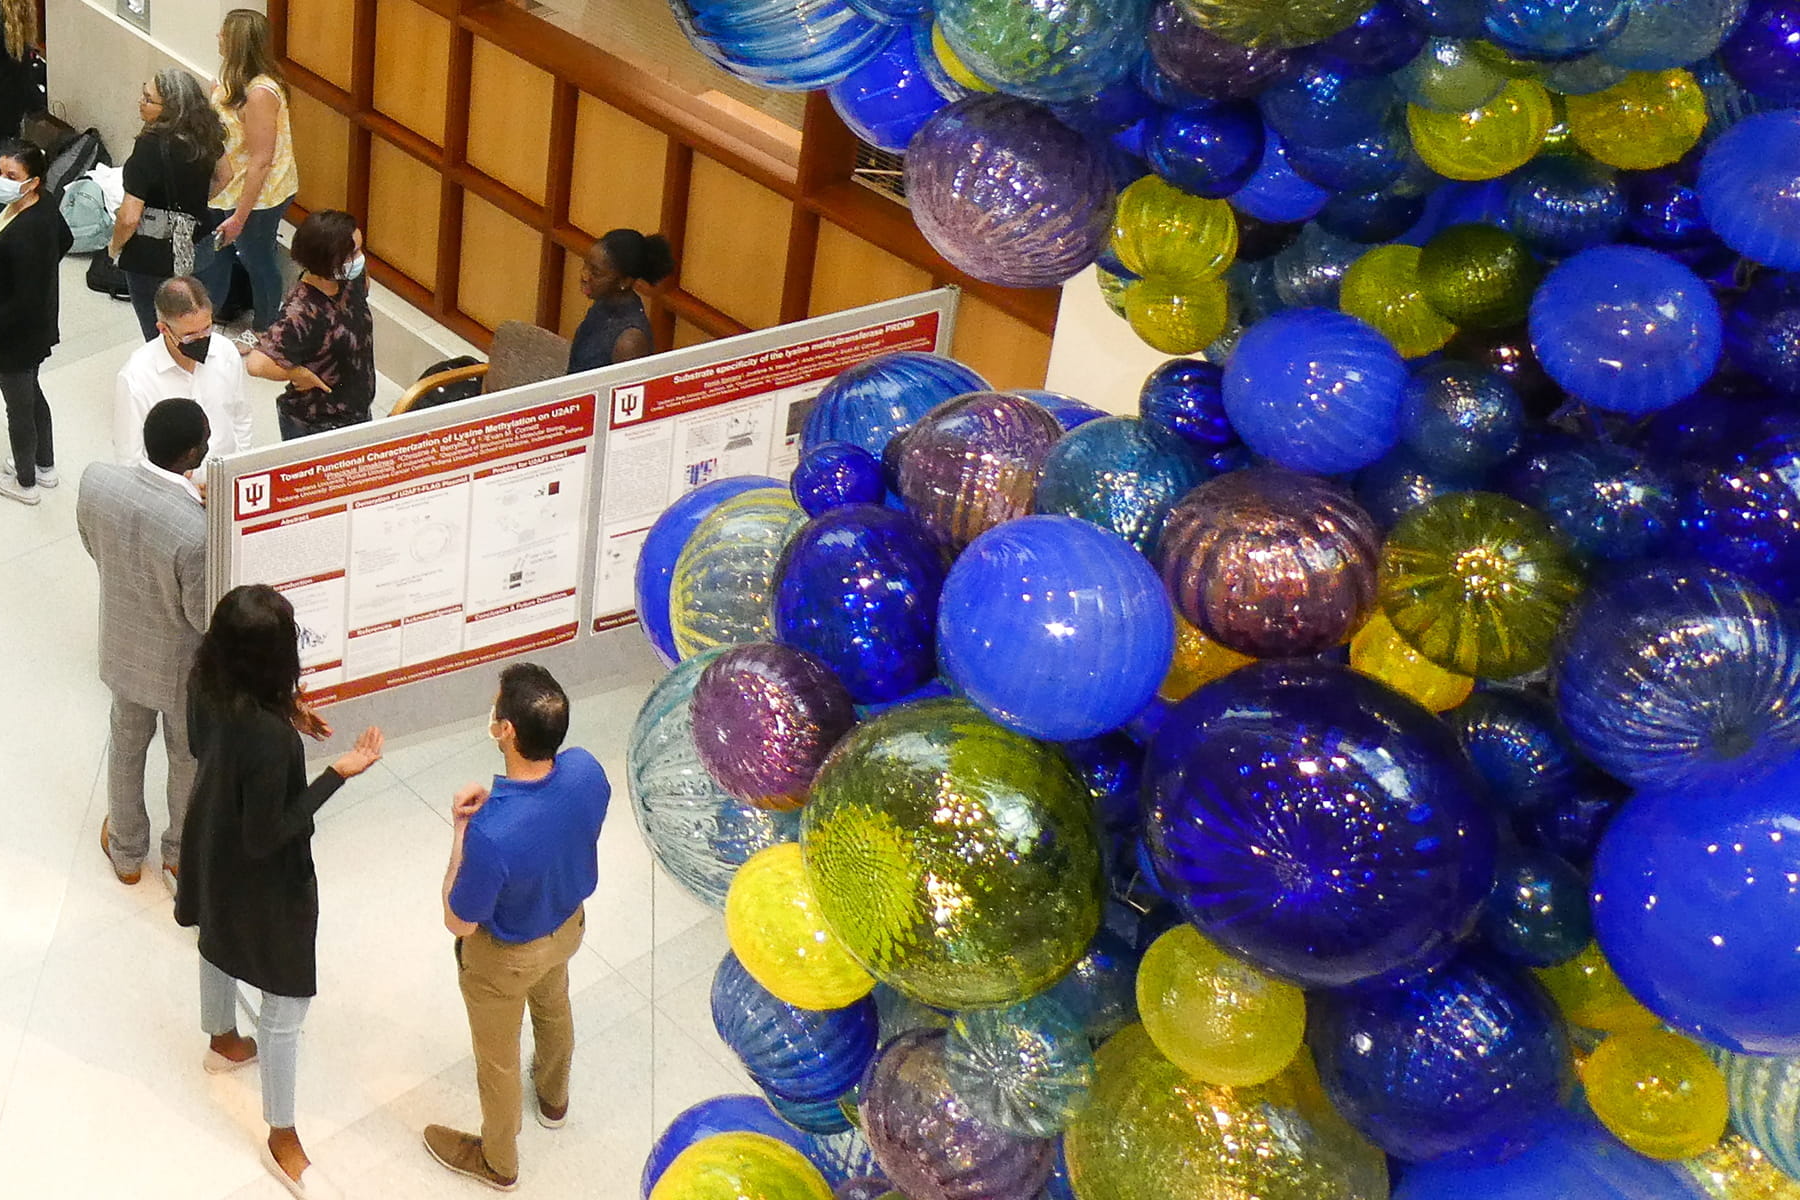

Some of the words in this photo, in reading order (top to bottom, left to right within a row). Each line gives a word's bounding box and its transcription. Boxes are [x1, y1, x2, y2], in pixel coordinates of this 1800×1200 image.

[673, 365, 714, 385] Substrate
[716, 356, 757, 375] specificity
[759, 354, 768, 363] of
[770, 350, 783, 361] the
[785, 344, 809, 358] lysine
[811, 326, 883, 352] methyltransferase
[280, 466, 313, 482] Toward
[316, 454, 364, 473] Functional
[367, 436, 439, 462] Characterization
[442, 434, 451, 443] of
[454, 426, 483, 442] Lysine
[485, 414, 536, 435] Methylation
[538, 412, 549, 421] on
[551, 404, 579, 418] U2AF1
[280, 513, 309, 526] Abstract
[274, 577, 312, 592] ntroduction
